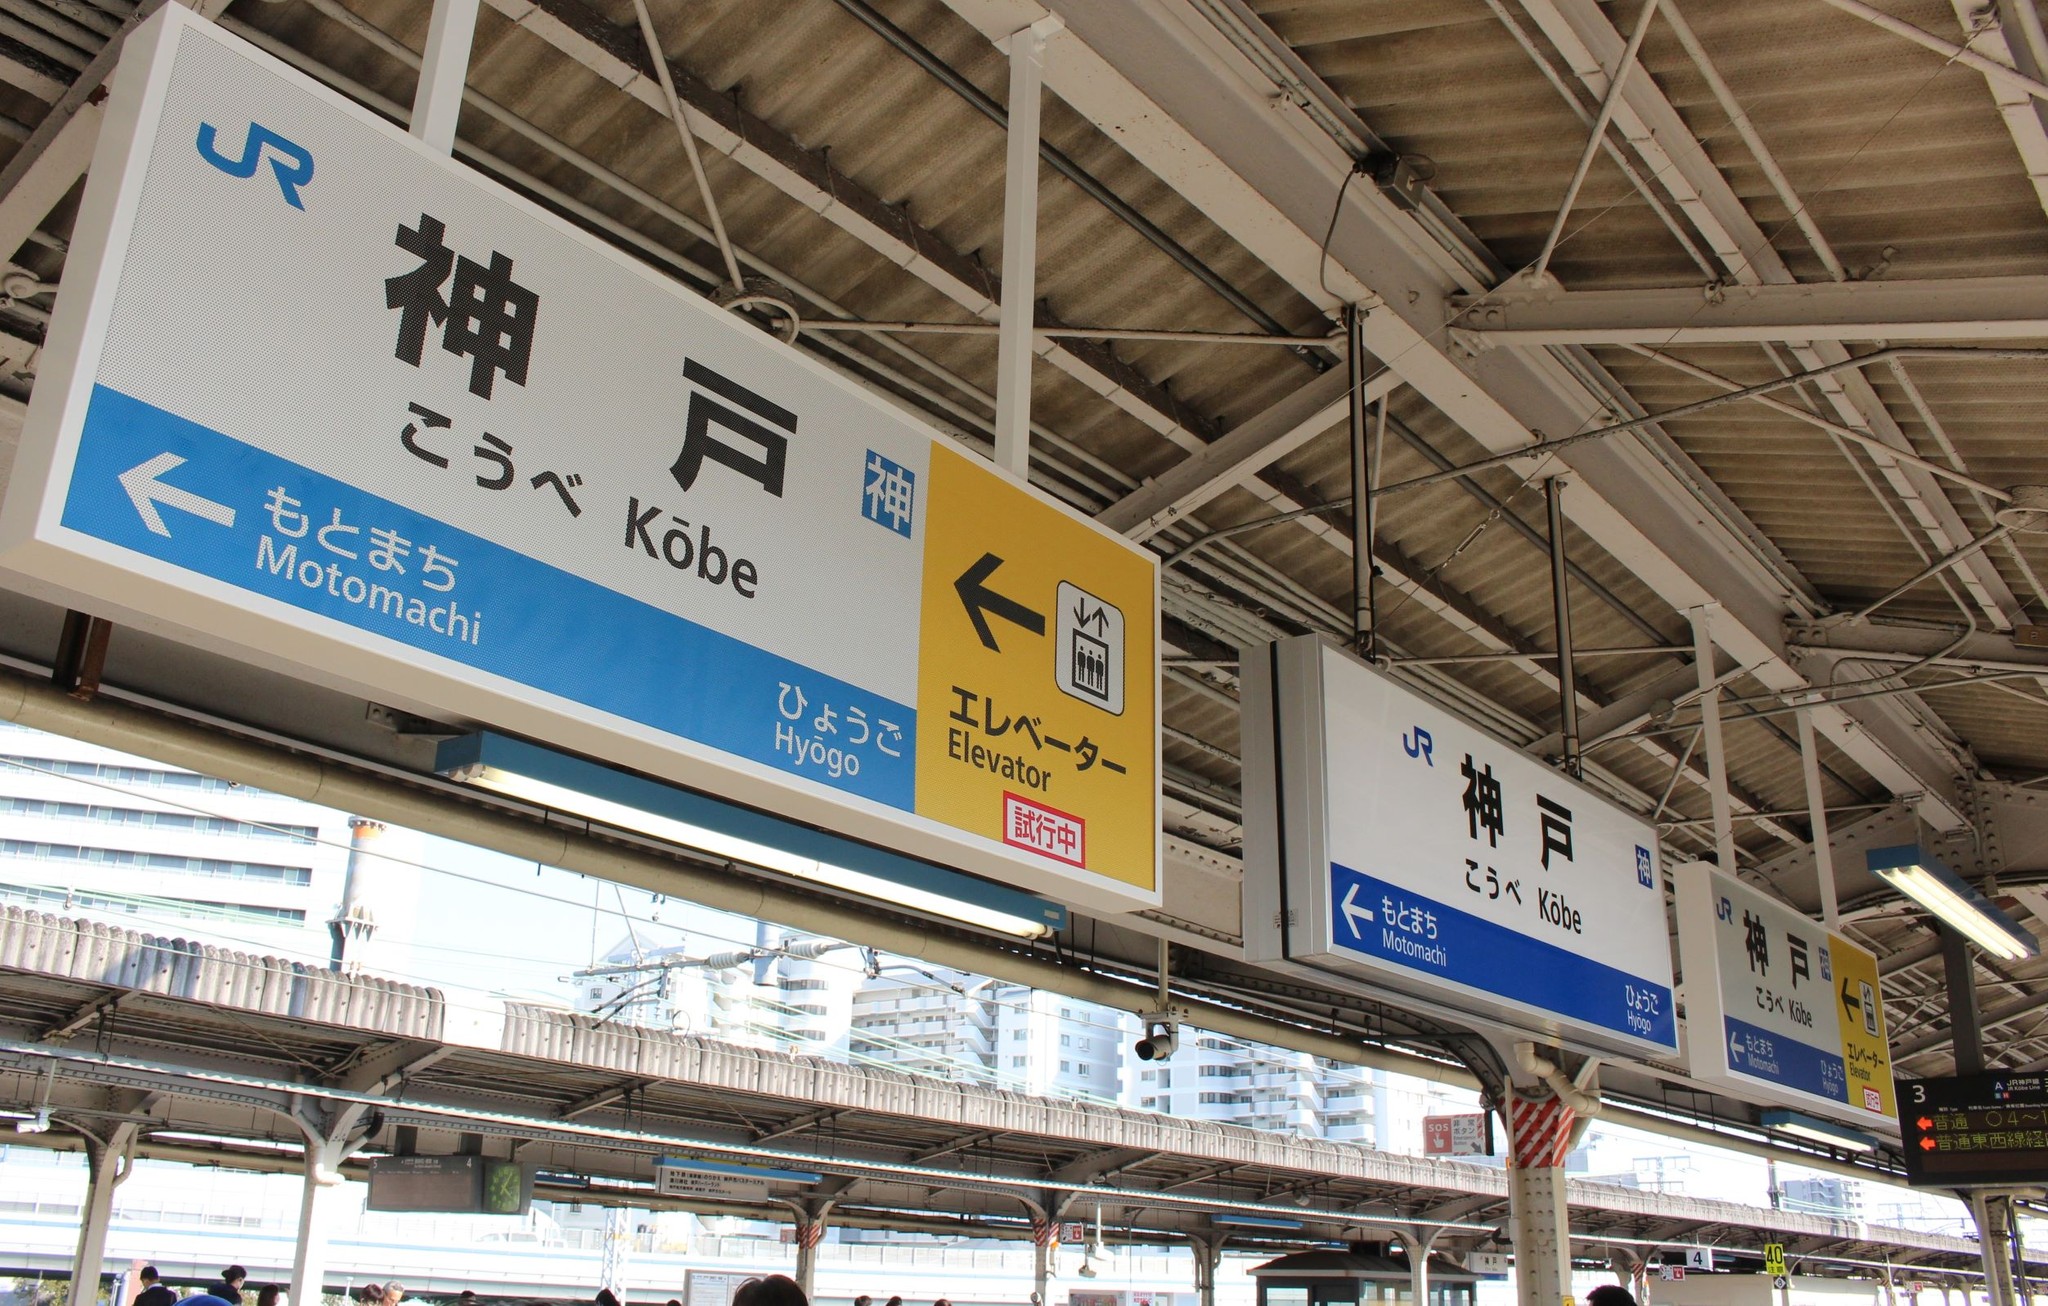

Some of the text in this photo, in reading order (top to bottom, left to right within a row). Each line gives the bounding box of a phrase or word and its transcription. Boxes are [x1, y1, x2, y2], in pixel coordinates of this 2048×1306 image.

[196, 121, 314, 212] JR
[385, 212, 798, 498] 神戸
[401, 402, 582, 517] こうべ
[866, 456, 911, 530] 神
[265, 487, 458, 592] もとまち
[624, 497, 758, 599] Kōbe
[256, 536, 481, 645] Motomachi
[779, 682, 901, 757] ひょうご
[950, 685, 1127, 775] エレベーター
[775, 721, 859, 778] Hyōgo
[949, 731, 1051, 791] Elevator
[1403, 726, 1433, 767] JR
[1013, 806, 1076, 855] 試行中
[1460, 753, 1574, 871] 神戸
[1465, 858, 1522, 906] こうべ
[1637, 848, 1651, 885] 神
[1382, 896, 1437, 939] もとまち
[1538, 887, 1582, 935] Kōbe
[1716, 896, 1733, 925] JR
[1383, 927, 1447, 967] Motomachi
[1743, 909, 1810, 990] 神戸
[1625, 984, 1659, 1016] ひょうご
[1756, 986, 1785, 1014] こうべ
[1788, 998, 1813, 1029] Kōbe
[1627, 1008, 1651, 1035] Hyōgo
[1745, 1032, 1773, 1058] もとまち
[1747, 1053, 1780, 1075] Motomachi
[1847, 1042, 1885, 1069] エレベーター
[1849, 1062, 1871, 1082] Elevator
[1995, 1081, 2004, 1090] A
[1912, 1085, 1926, 1103] 3
[1429, 1123, 1449, 1132] SOS
[1454, 1127, 1475, 1135] ボタン
[1935, 1113, 1968, 1130] 普通
[373, 1159, 378, 1169] 5
[466, 1157, 472, 1168] 4
[1693, 1251, 1703, 1266] 4
[1767, 1245, 1783, 1264] 40
